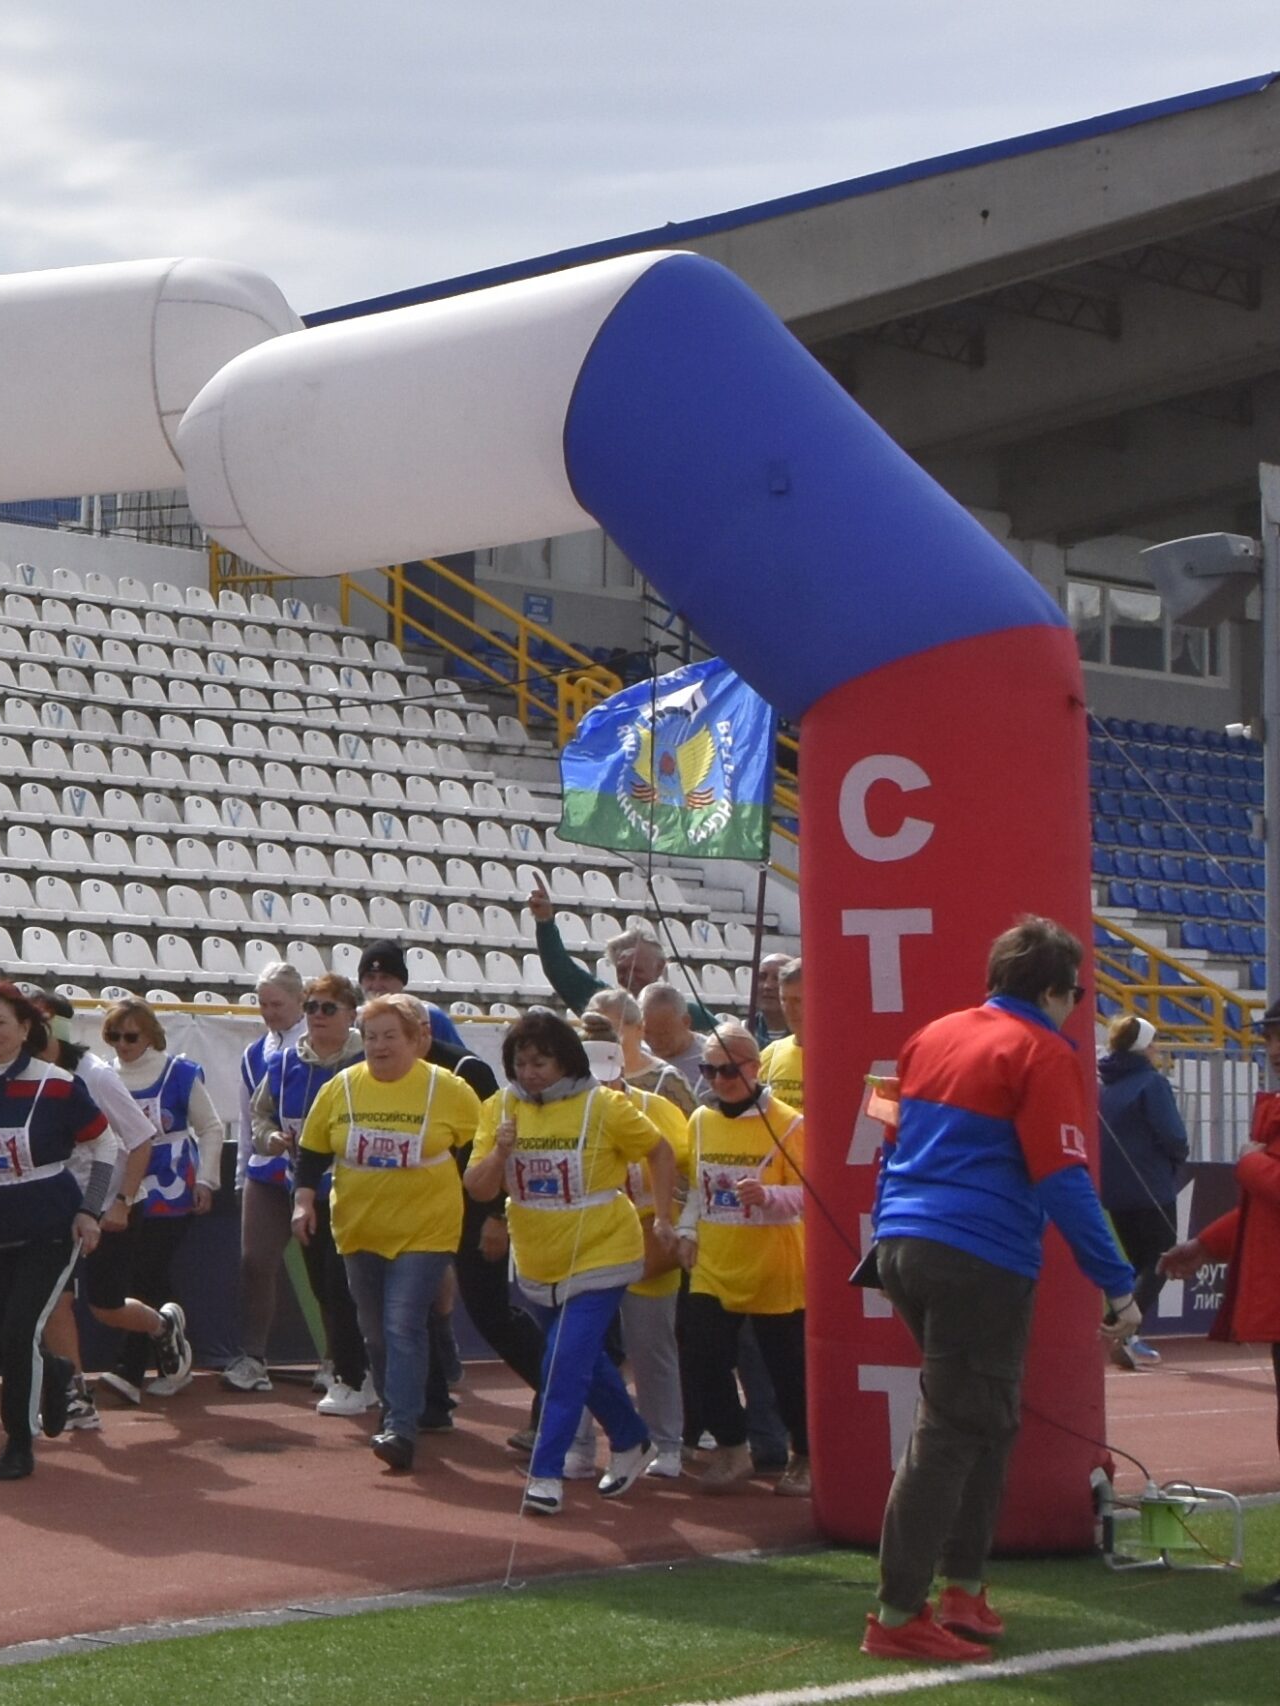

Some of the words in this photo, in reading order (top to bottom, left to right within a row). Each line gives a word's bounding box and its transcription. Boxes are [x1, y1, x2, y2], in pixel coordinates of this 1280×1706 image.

[373, 1136, 395, 1152] ГТО
[529, 1158, 552, 1173] ГТО
[539, 1179, 549, 1192] 2
[721, 1193, 730, 1205] 6
